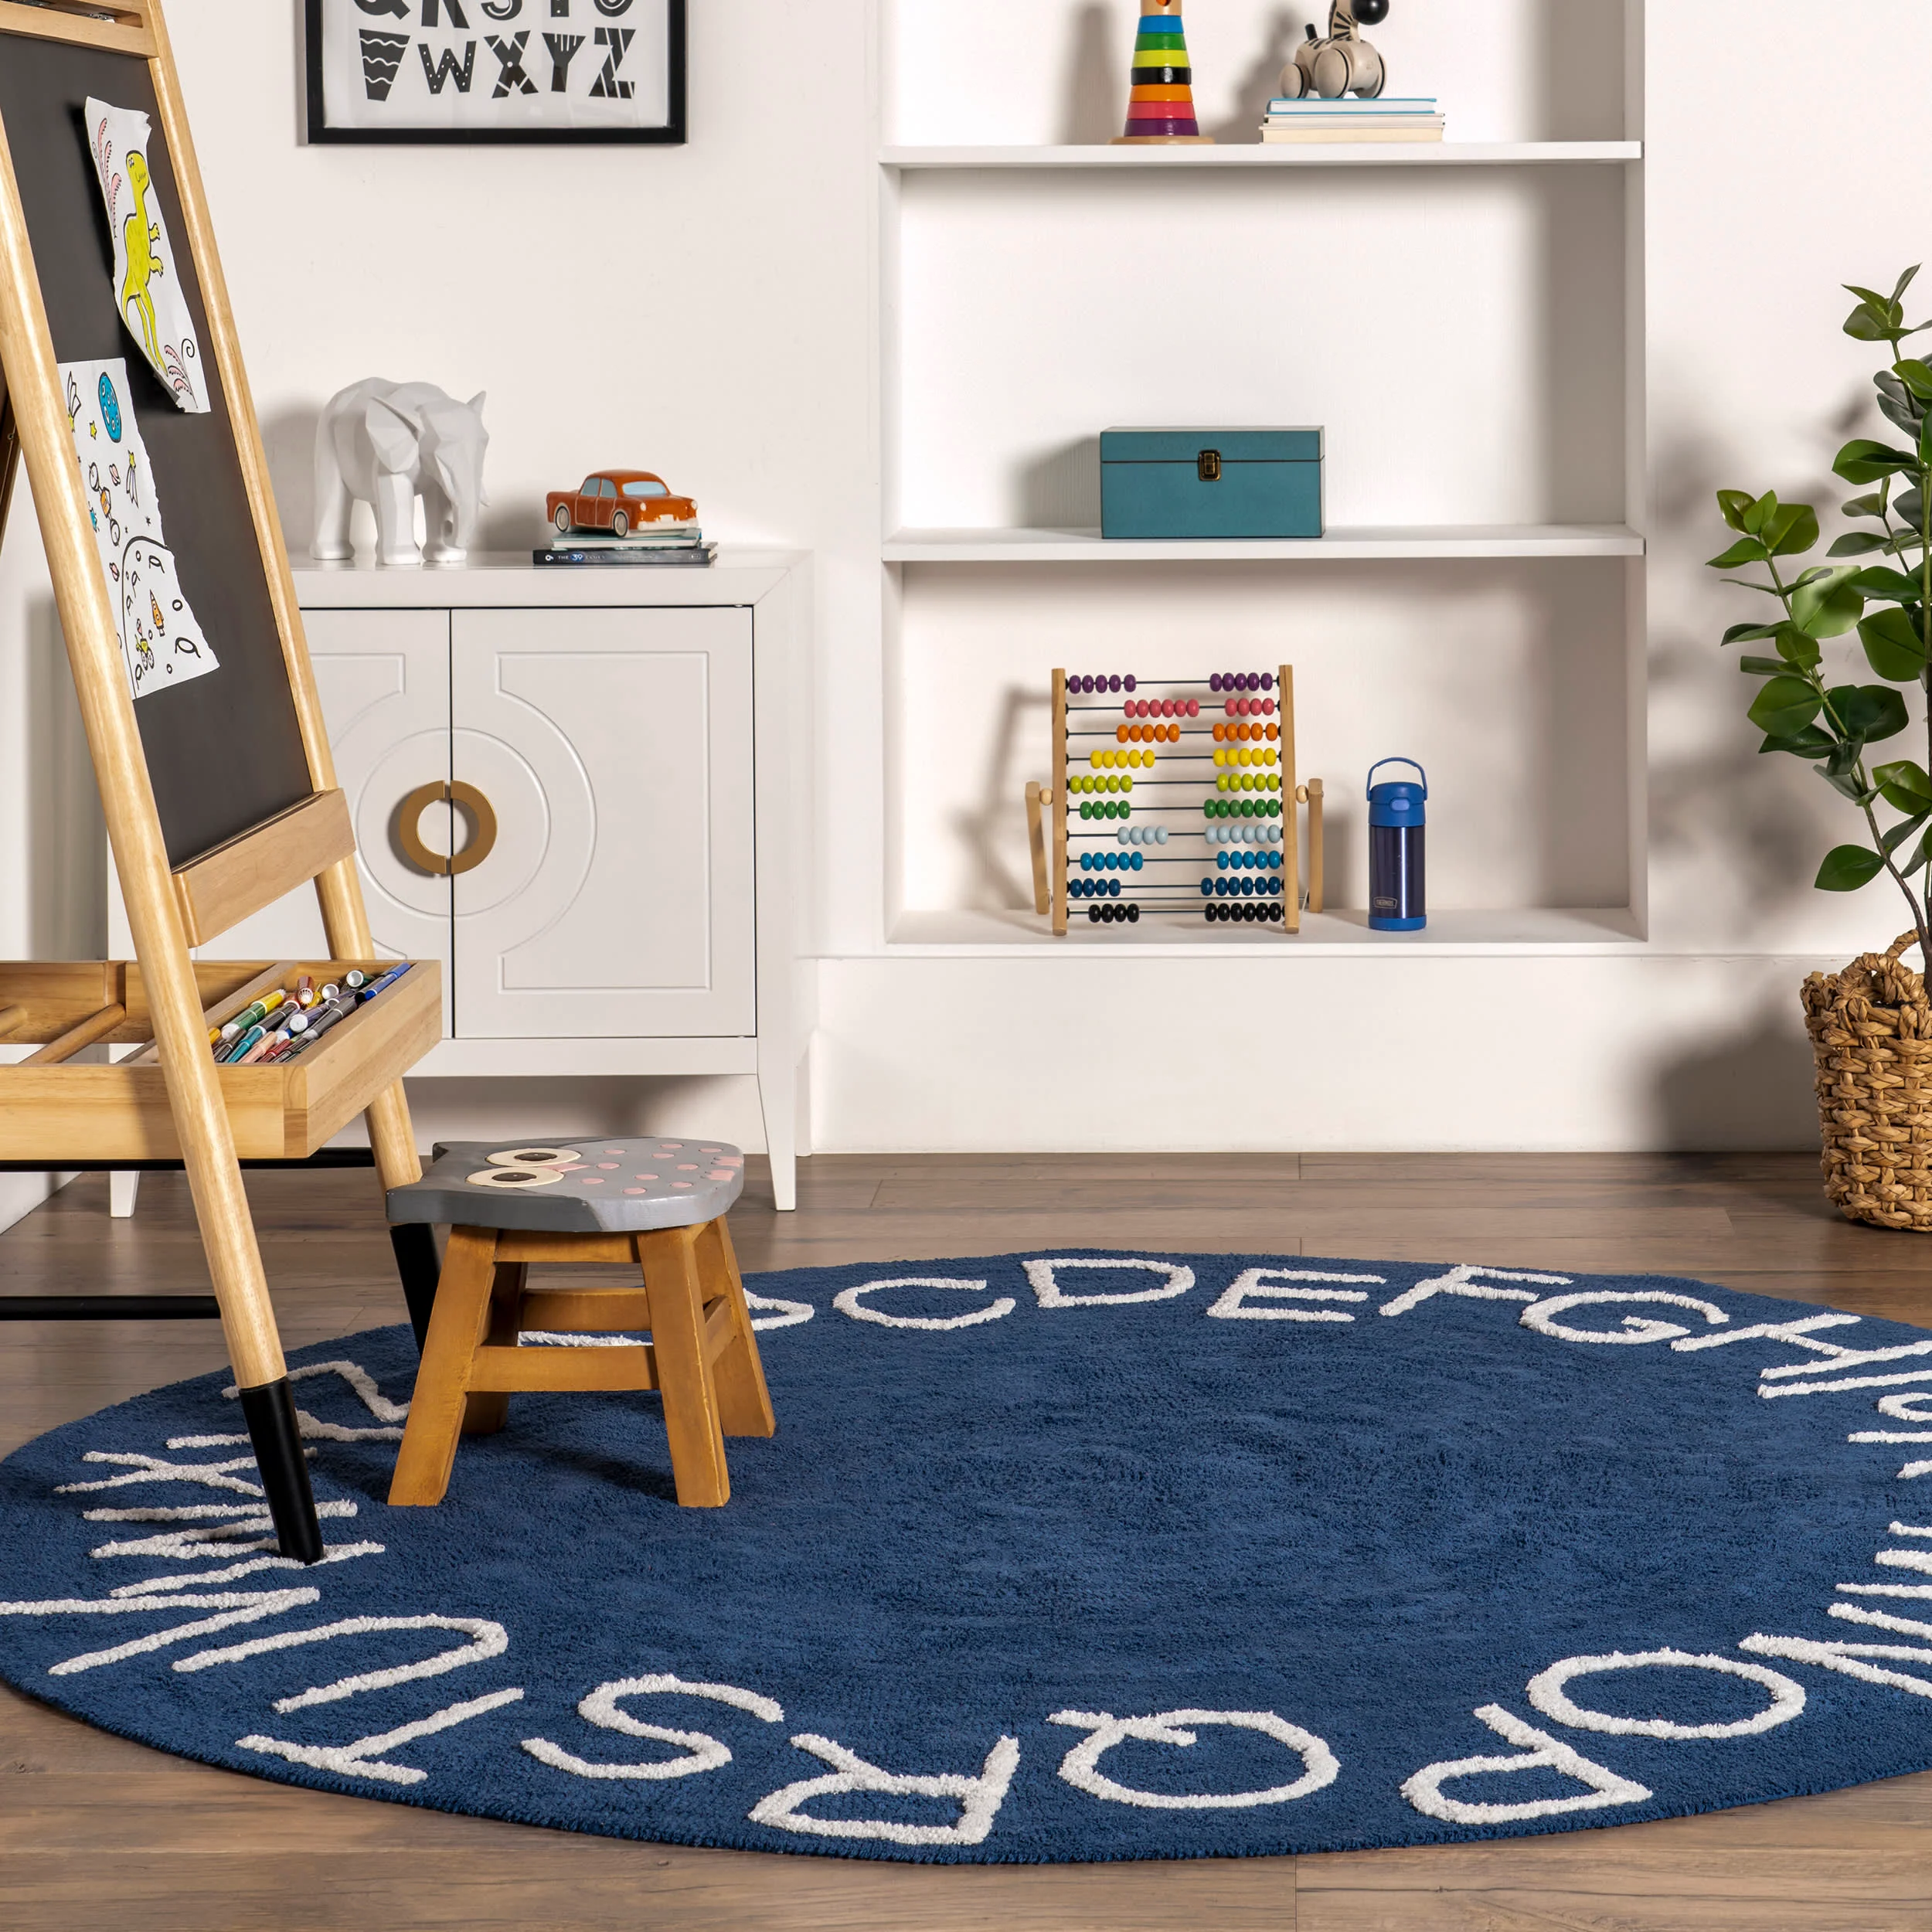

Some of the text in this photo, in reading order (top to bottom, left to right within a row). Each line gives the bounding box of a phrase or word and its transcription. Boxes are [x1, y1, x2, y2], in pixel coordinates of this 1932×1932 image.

[833, 1277, 1016, 1330] C
[1022, 1258, 1195, 1309] D
[1207, 1267, 1386, 1322] E
[1379, 1264, 1573, 1317] F
[1520, 1289, 1730, 1345] G
[1670, 1312, 1932, 1380] H
[0, 1587, 321, 1675] V
[172, 1614, 508, 1714] U
[235, 1687, 525, 1785] T
[521, 1674, 784, 1781] S
[1526, 1647, 1806, 1740] O
[748, 1733, 1020, 1846] R
[1047, 1708, 1341, 1809] Q
[1400, 1702, 1653, 1825] P
